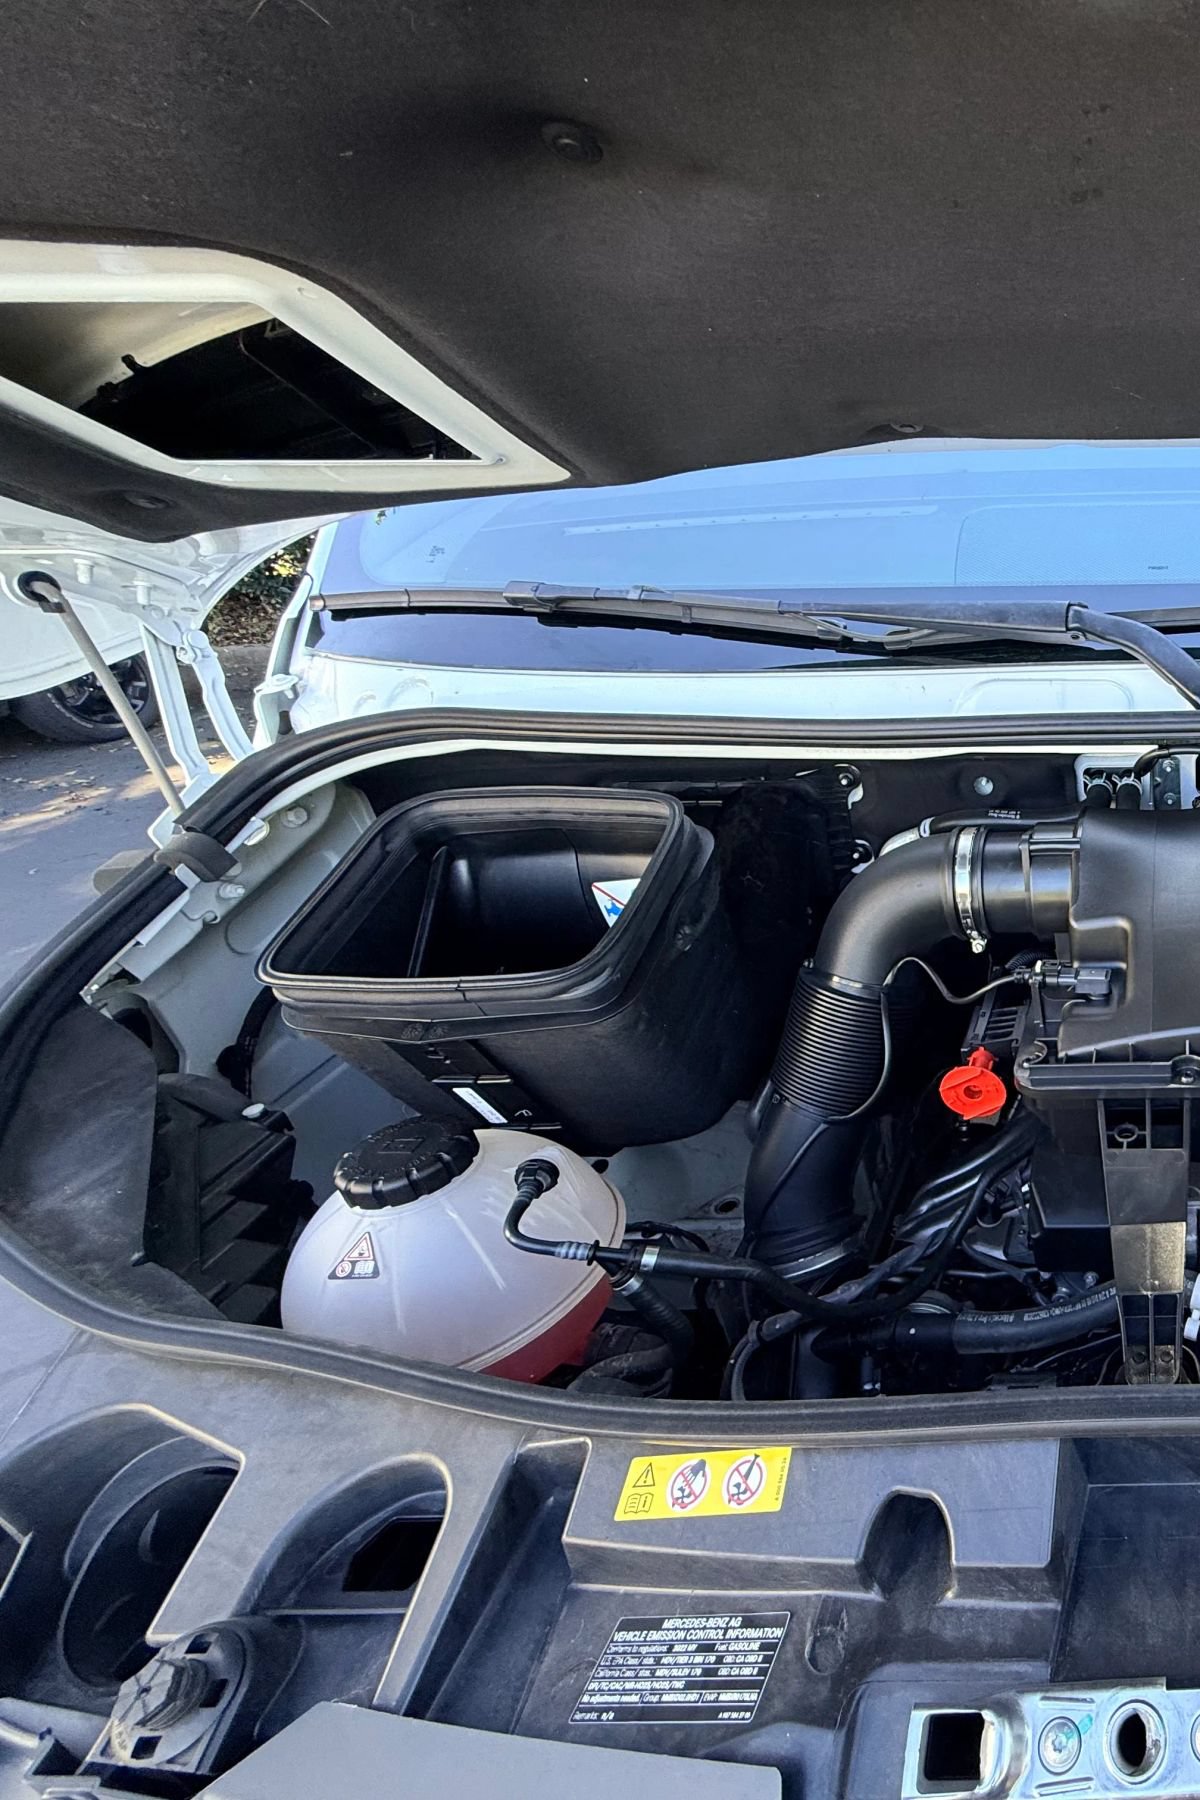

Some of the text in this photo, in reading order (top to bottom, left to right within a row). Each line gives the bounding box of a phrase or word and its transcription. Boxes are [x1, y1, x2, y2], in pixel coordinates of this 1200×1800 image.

[661, 1617, 742, 1628] MERCEDES-BENZ AG
[613, 1627, 782, 1641] VEHICLE EMISSION CONTROL INFORMATION
[728, 1642, 760, 1650] GASOLINE
[744, 1654, 757, 1662] OBD
